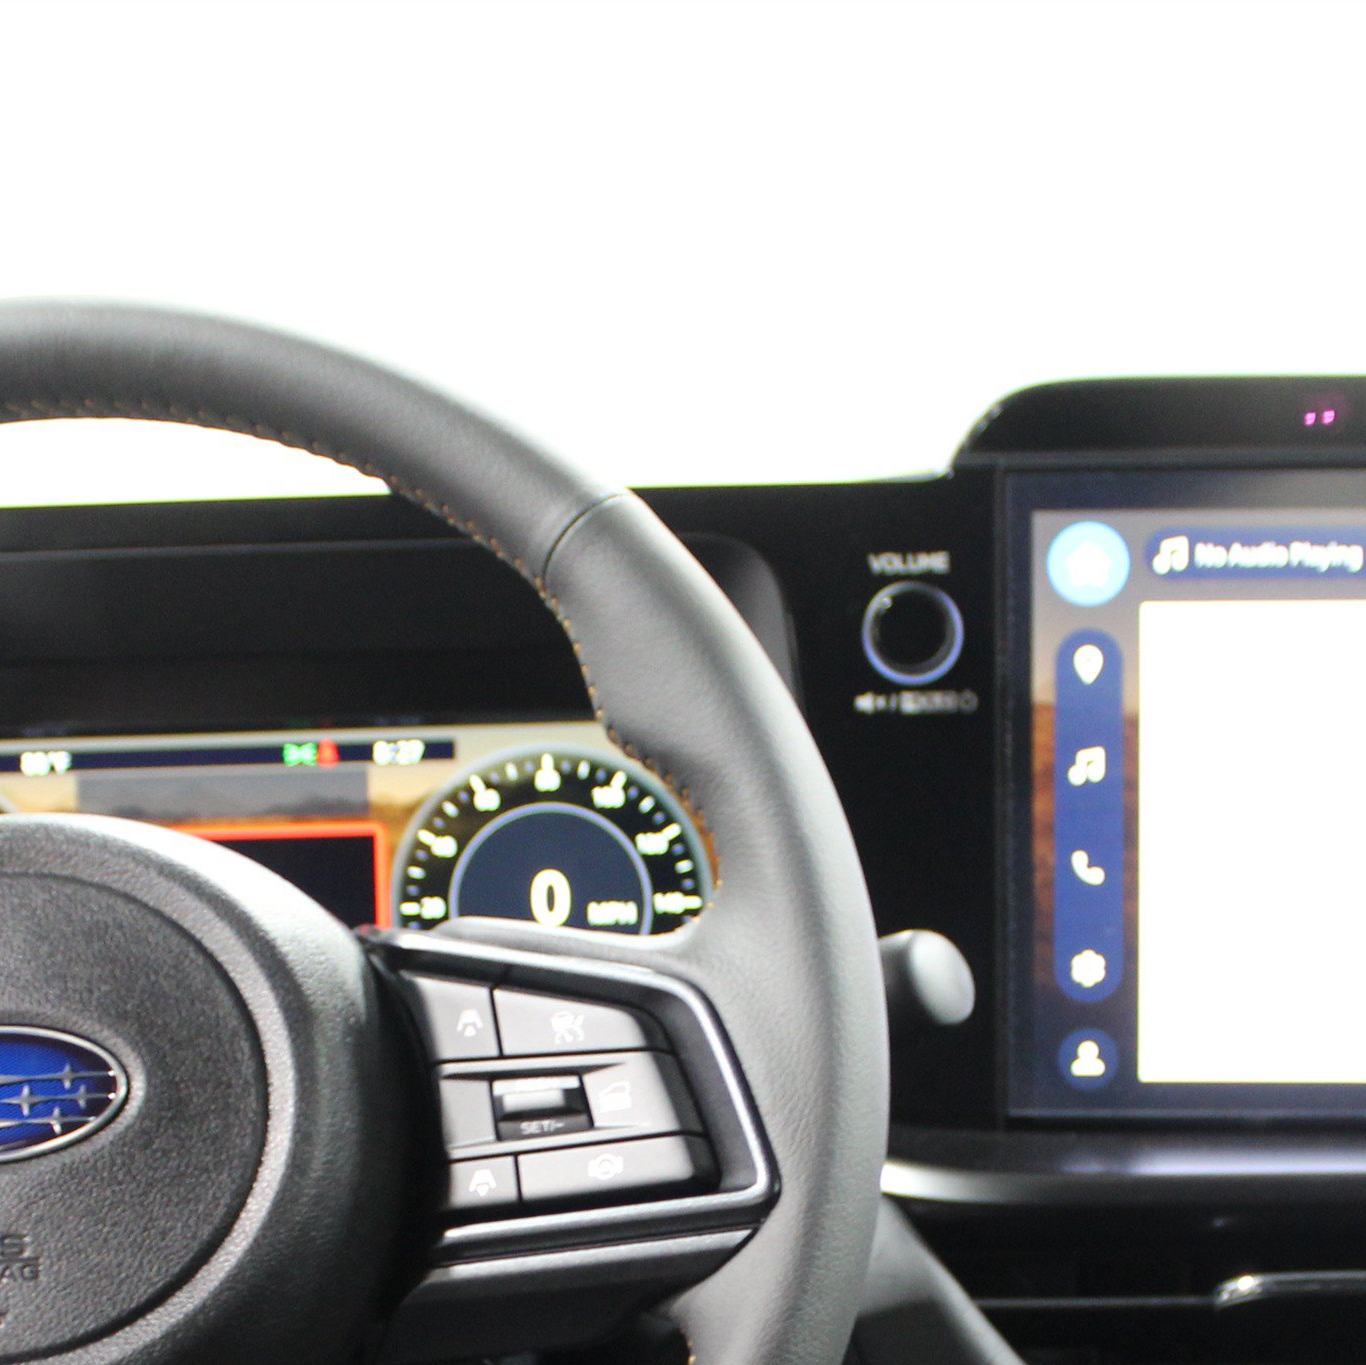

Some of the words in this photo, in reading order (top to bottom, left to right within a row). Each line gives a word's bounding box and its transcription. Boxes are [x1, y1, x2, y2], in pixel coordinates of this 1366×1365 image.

[867, 551, 951, 575] VOLUME
[1195, 542, 1227, 567] No
[1228, 541, 1289, 567] Audio
[1290, 541, 1363, 572] Playing
[374, 740, 424, 765] 8:27
[531, 869, 571, 927] 0
